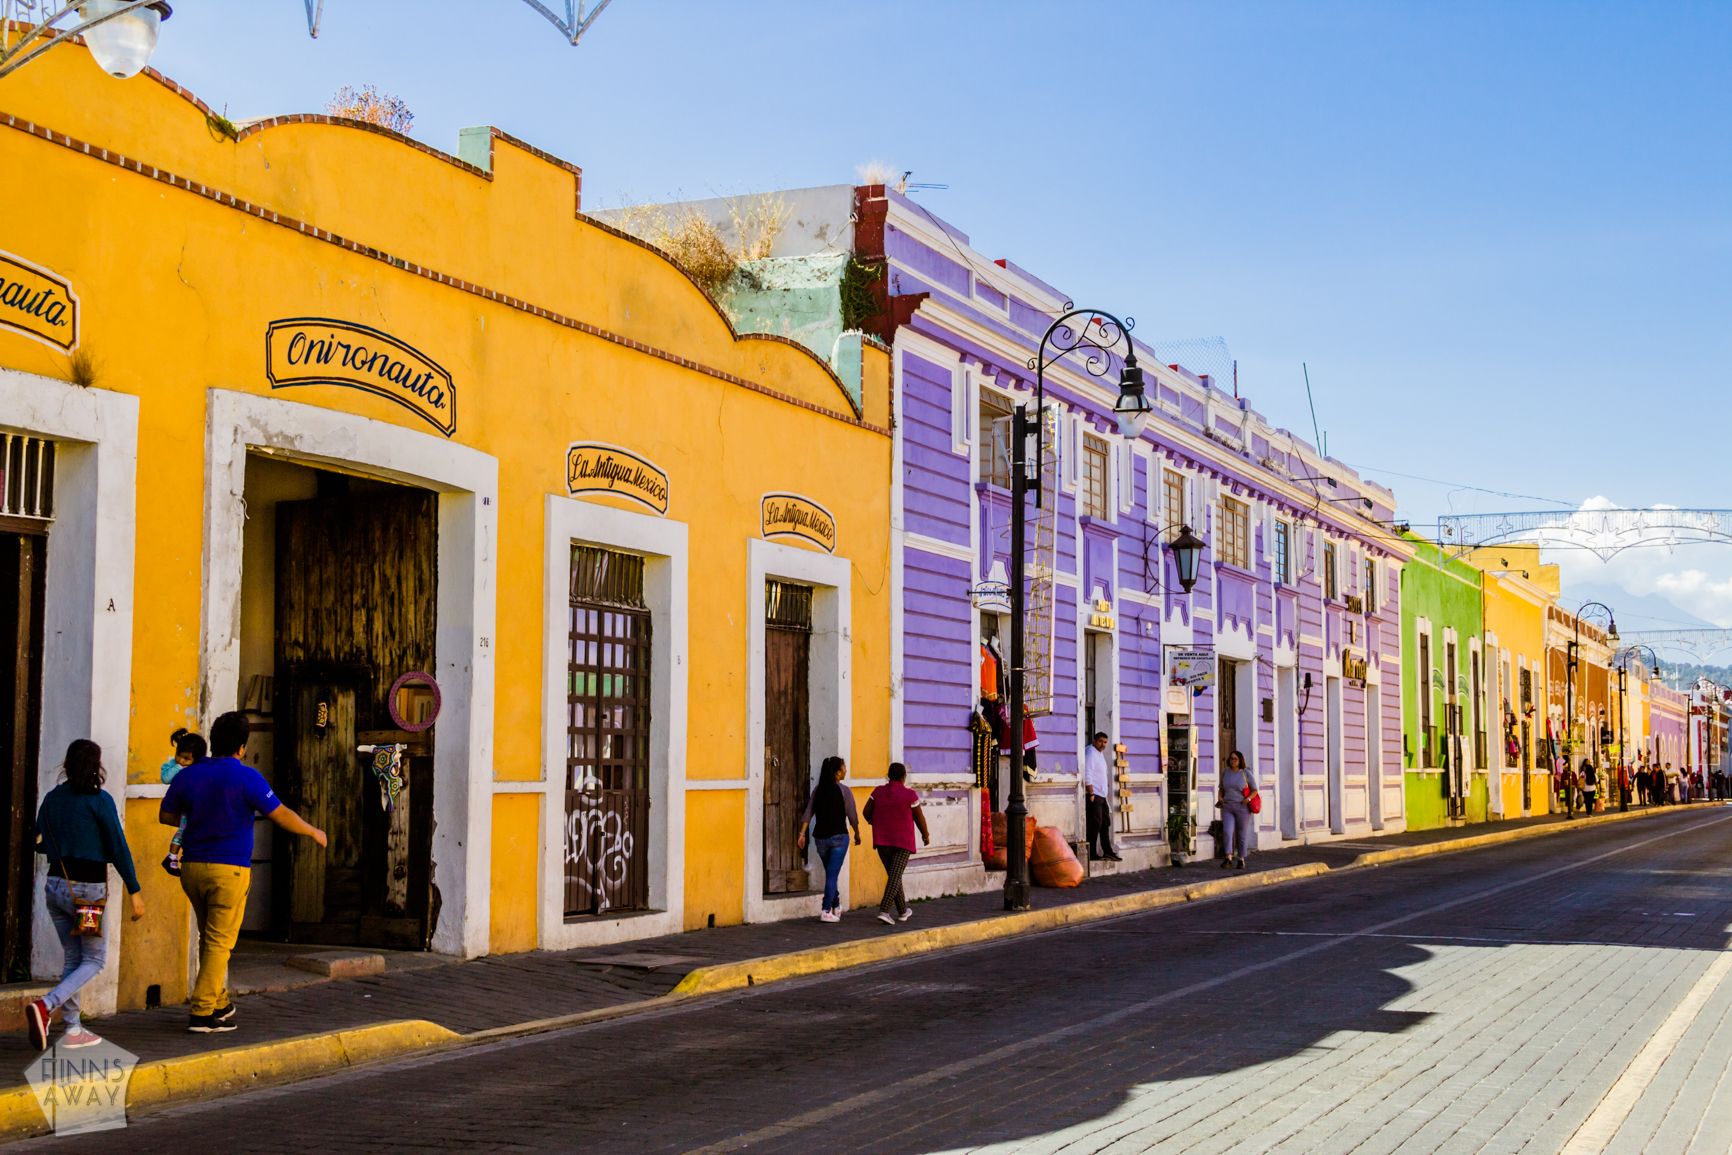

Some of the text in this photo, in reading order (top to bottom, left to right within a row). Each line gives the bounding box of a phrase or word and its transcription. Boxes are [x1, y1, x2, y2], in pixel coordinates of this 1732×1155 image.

[287, 331, 446, 409] Onironauta
[569, 453, 589, 483] La
[589, 453, 633, 489] Antigua
[765, 502, 781, 526] La
[780, 502, 809, 532] Antigua
[106, 598, 116, 612] A
